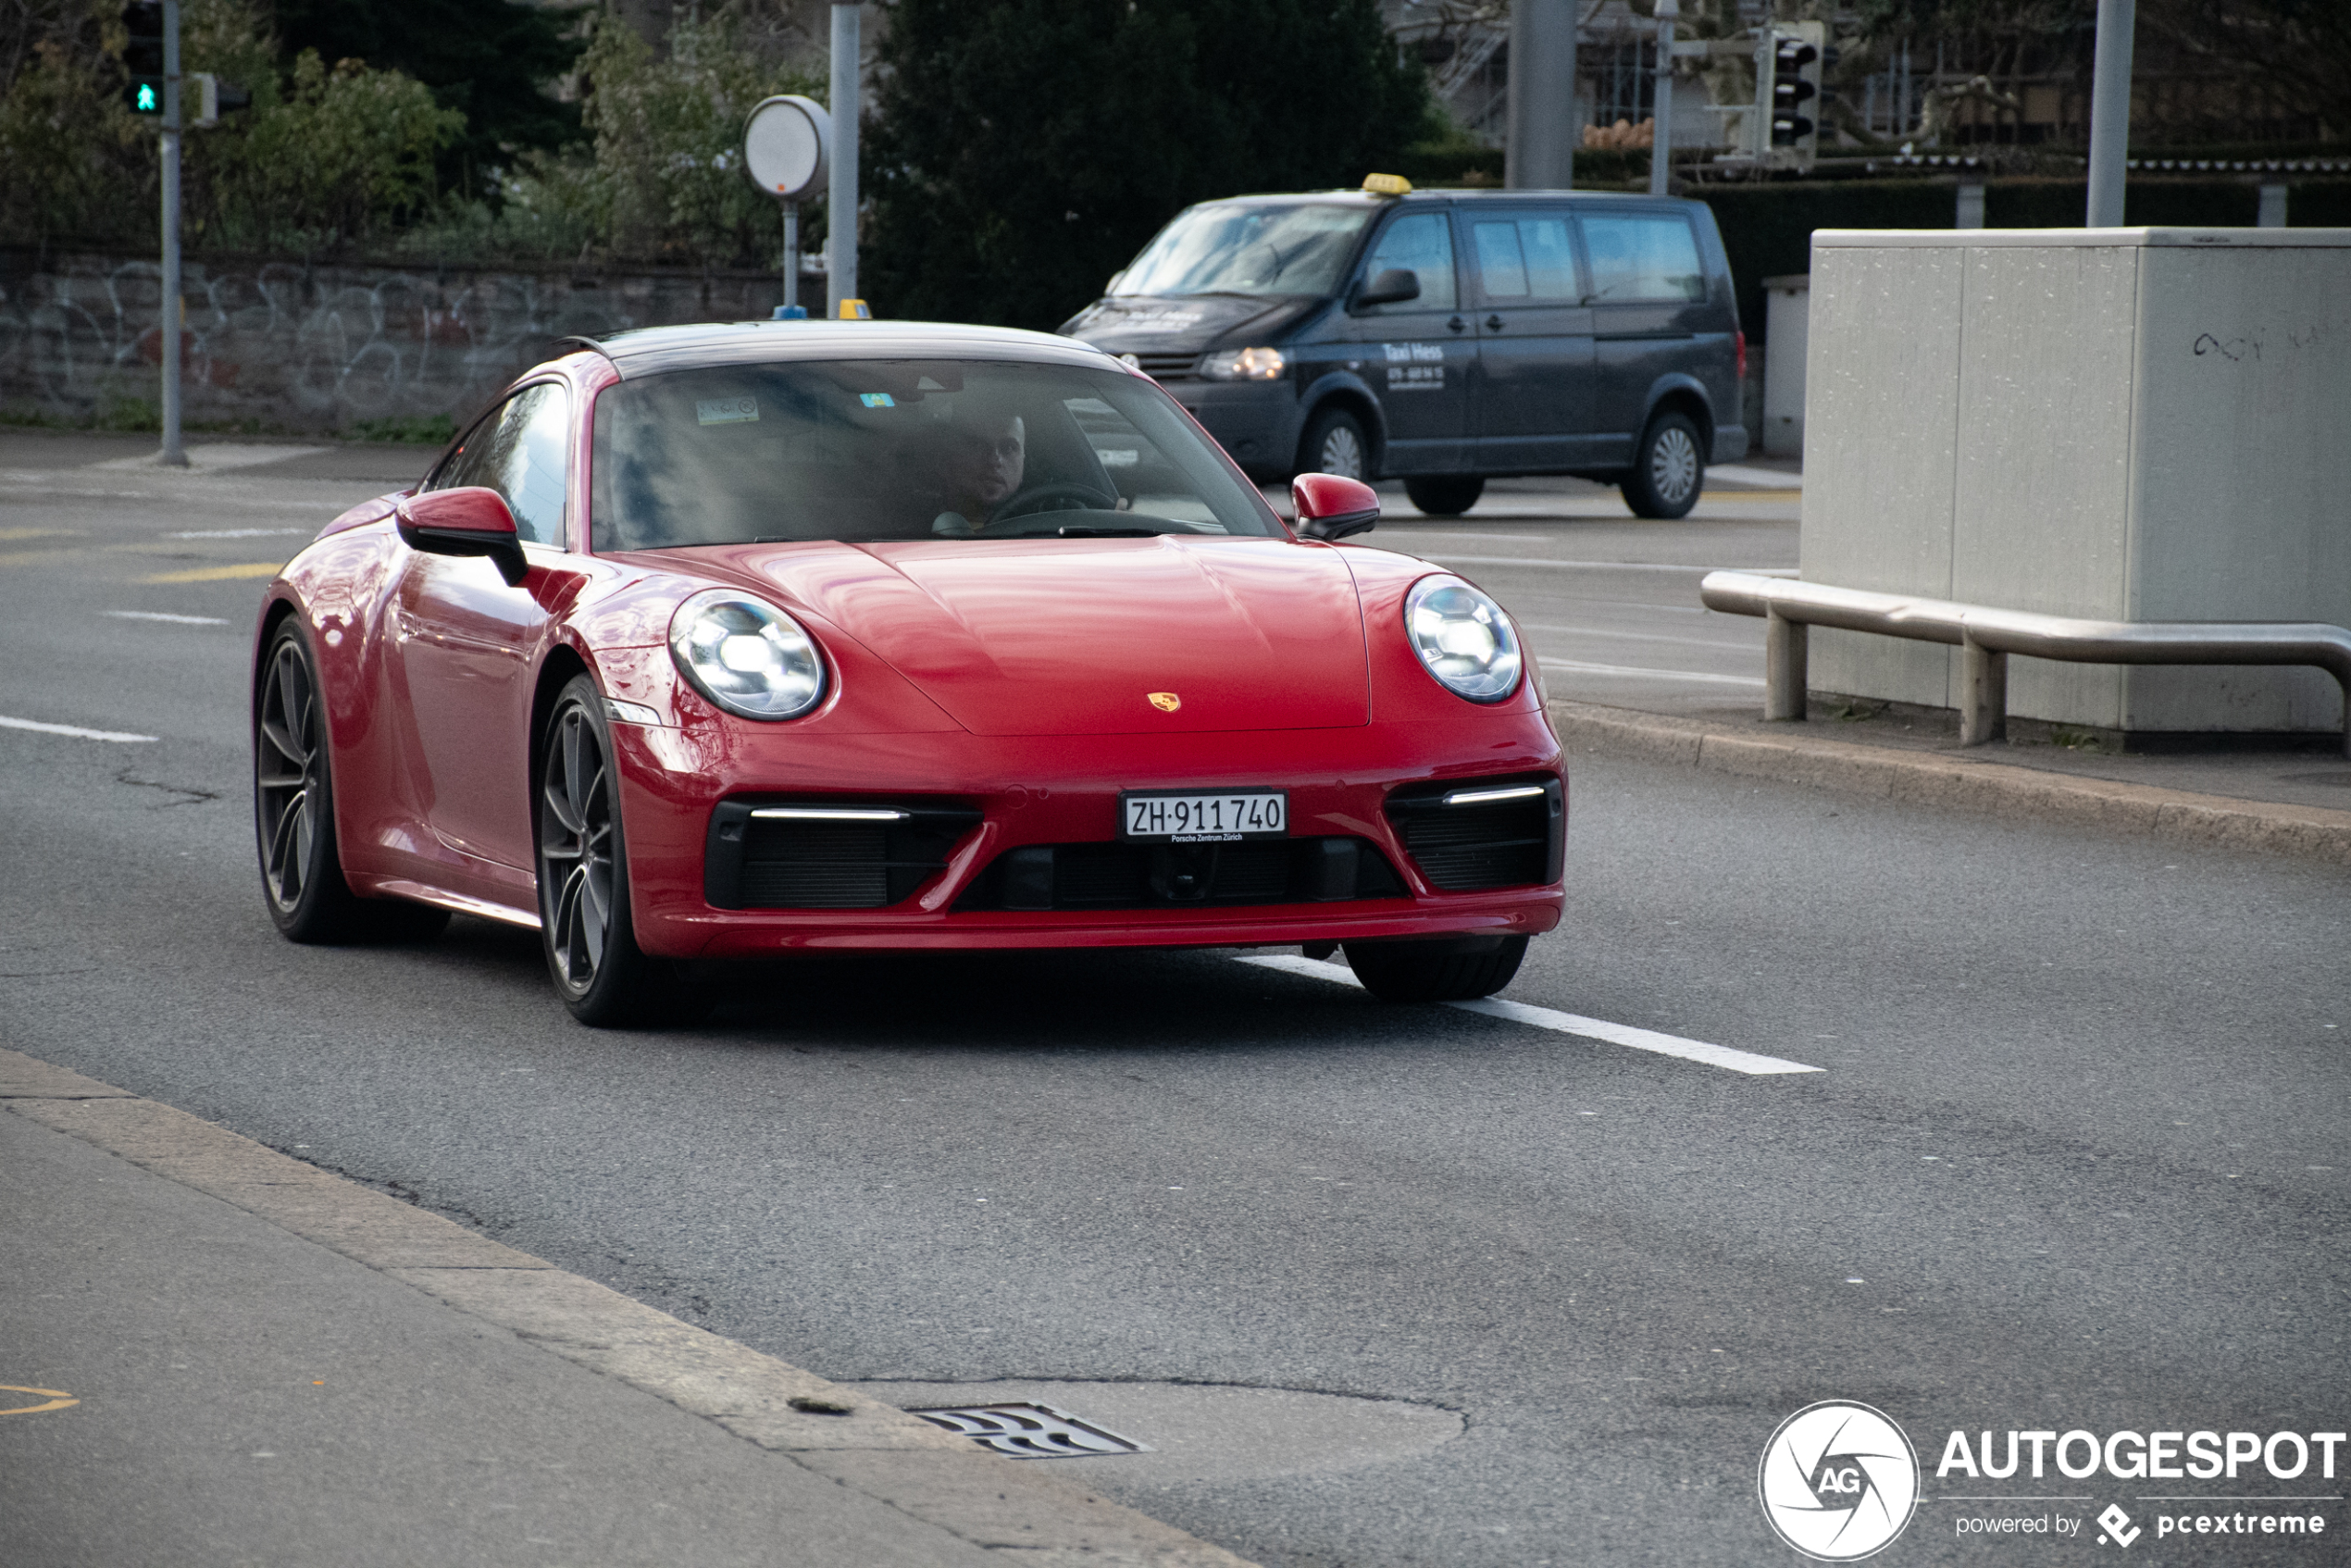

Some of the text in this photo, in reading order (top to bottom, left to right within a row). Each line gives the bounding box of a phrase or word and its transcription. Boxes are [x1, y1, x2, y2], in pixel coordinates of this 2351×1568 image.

[1171, 833, 1243, 842] Porsche Zentrum Zürich
